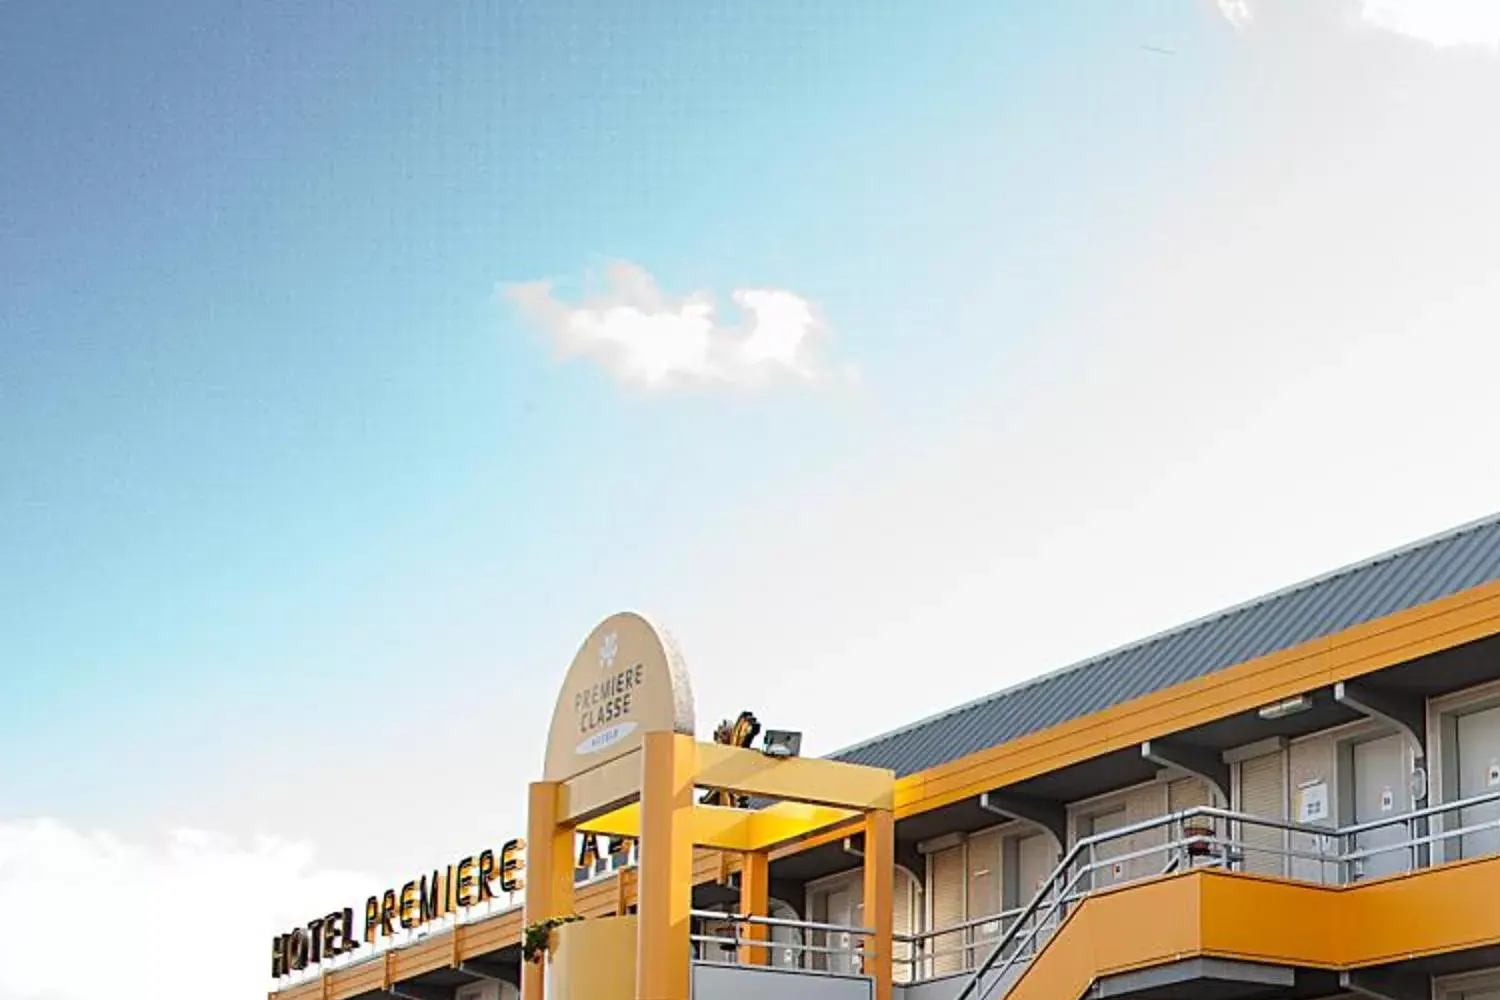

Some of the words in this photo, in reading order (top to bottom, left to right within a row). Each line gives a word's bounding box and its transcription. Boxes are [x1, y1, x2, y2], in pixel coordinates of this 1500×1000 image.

[575, 663, 643, 712] PREMIERE
[581, 693, 631, 733] CLASSE
[271, 907, 361, 979] HOTEL
[363, 837, 528, 943] PREMIERE
